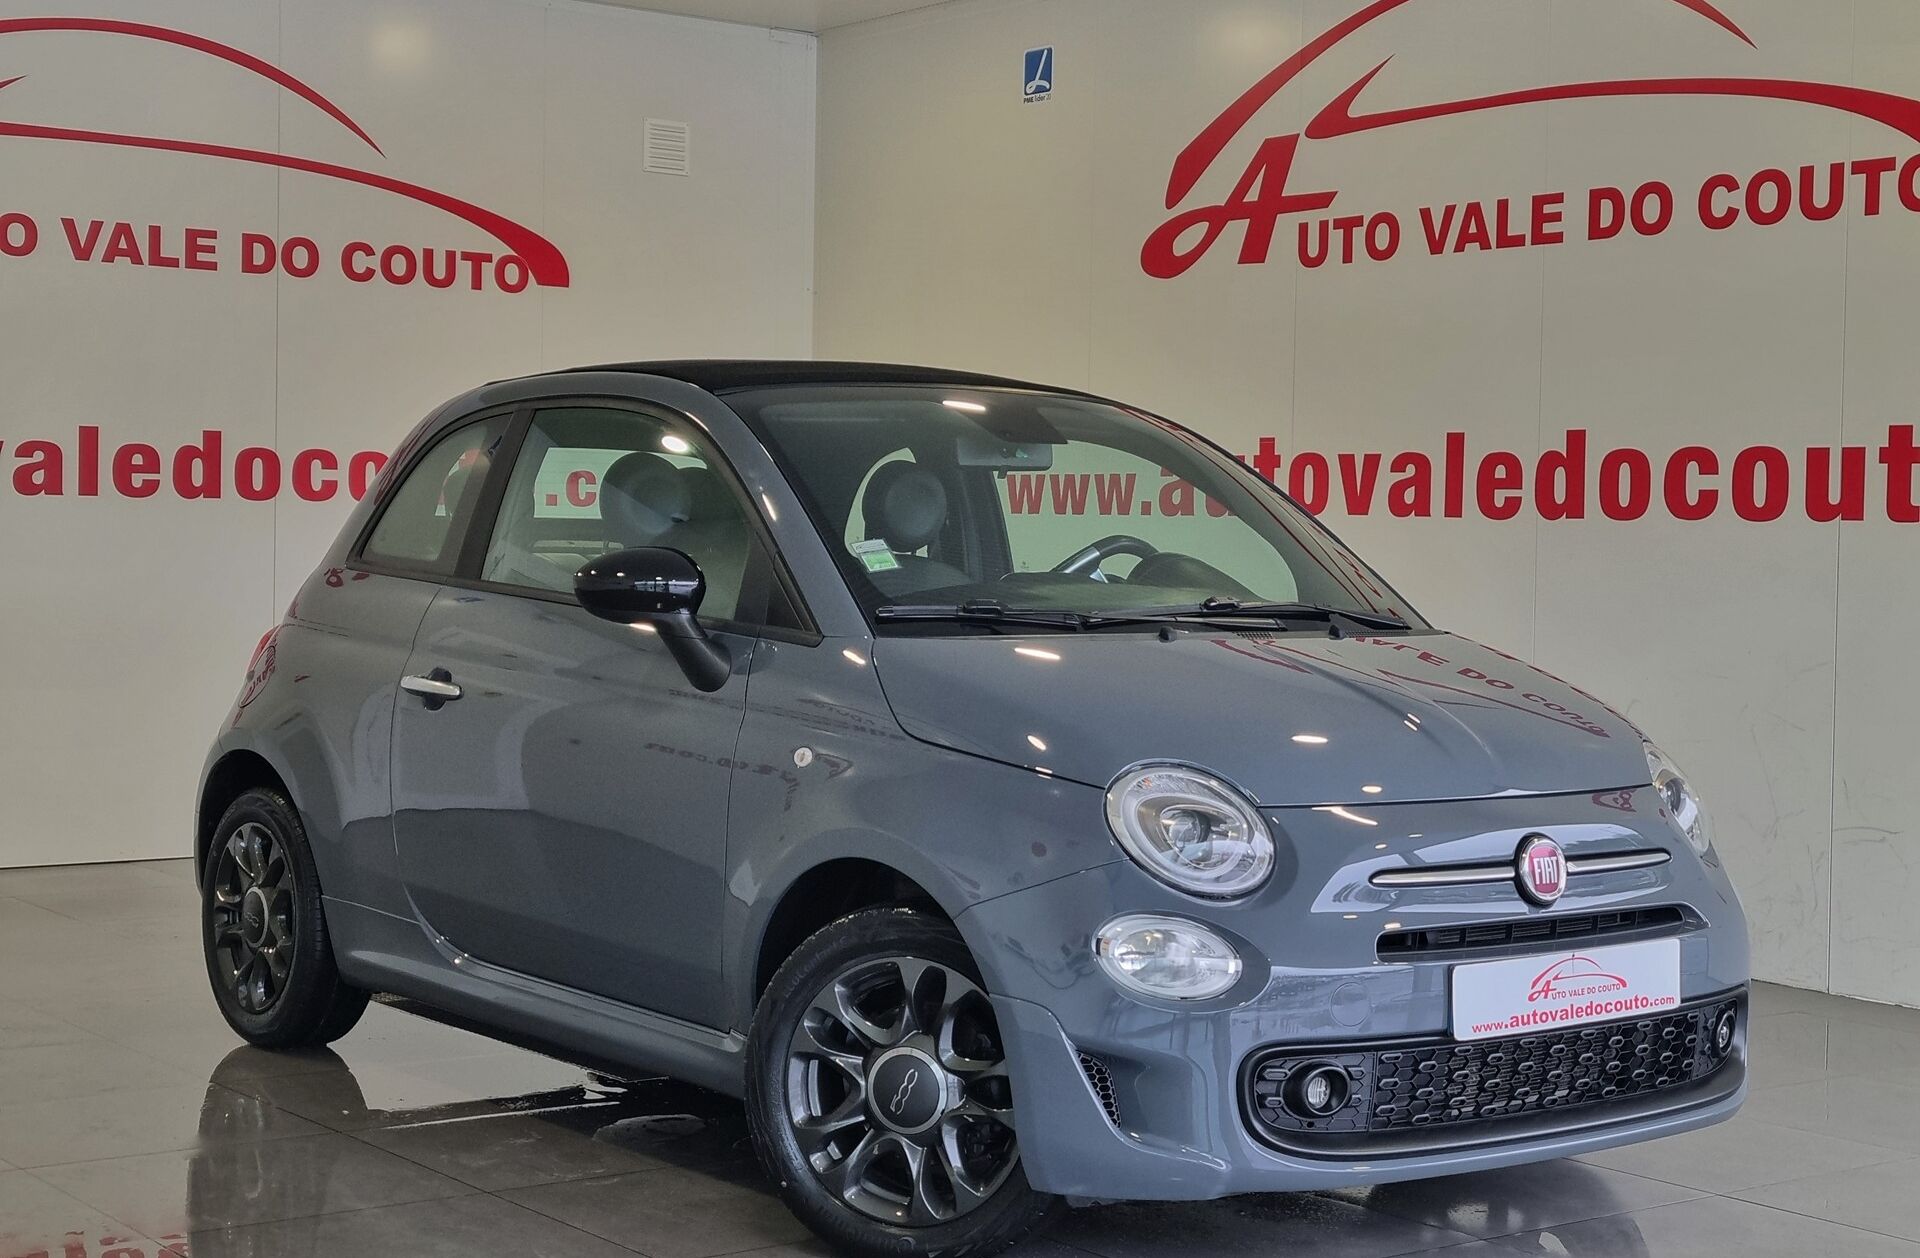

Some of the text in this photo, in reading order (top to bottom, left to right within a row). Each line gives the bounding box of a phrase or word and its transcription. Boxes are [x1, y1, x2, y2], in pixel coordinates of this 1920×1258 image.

[1141, 134, 1400, 280] AUTO
[1420, 192, 1564, 256] VALE
[1588, 181, 1674, 240] DO
[61, 218, 219, 272] VALE
[241, 232, 320, 279] DO
[341, 241, 529, 294] COUTO
[0, 426, 390, 502] aledoco
[1533, 856, 1558, 885] FIAT
[1471, 995, 1675, 1034] www.autovaledocouto.com
[1528, 980, 1621, 1002] AUTO VALE DO COUTO
